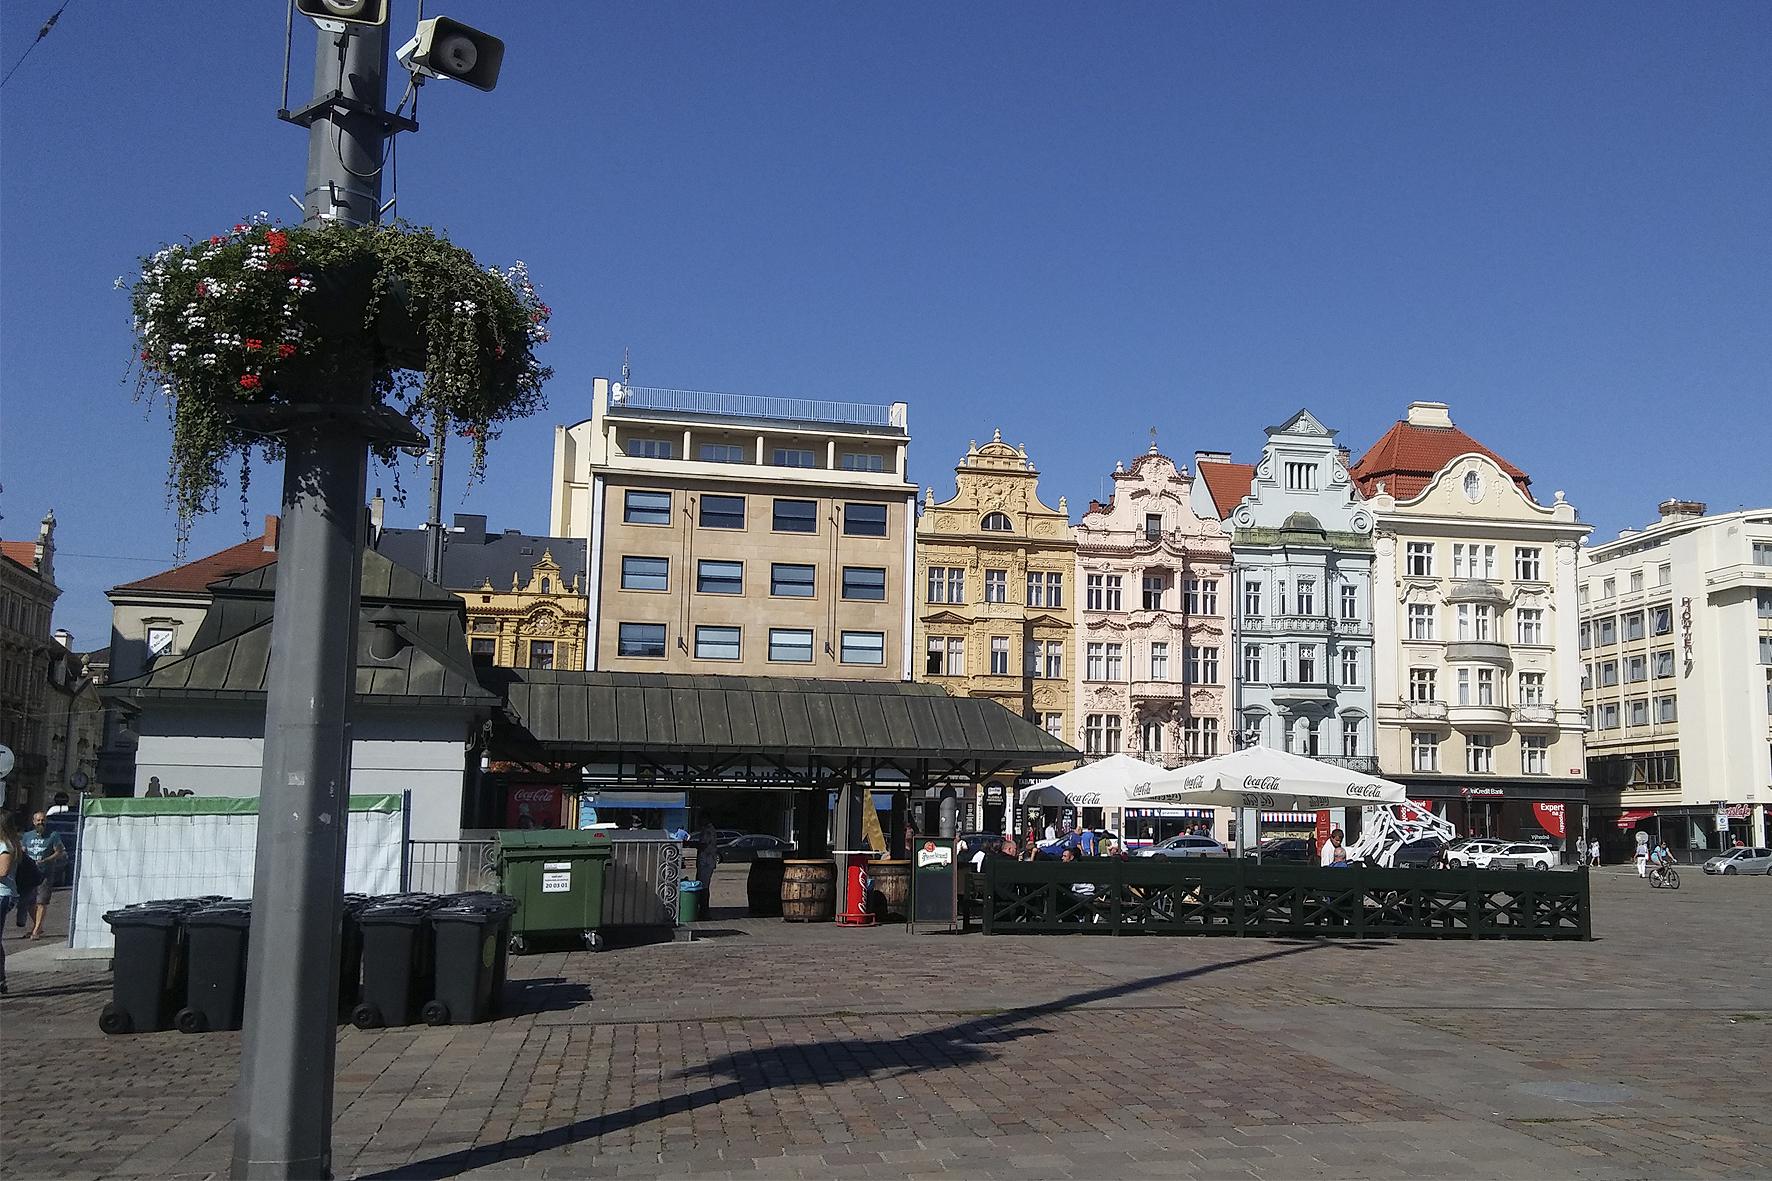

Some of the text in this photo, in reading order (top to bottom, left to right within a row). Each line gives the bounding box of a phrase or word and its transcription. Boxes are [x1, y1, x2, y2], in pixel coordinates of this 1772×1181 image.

[1243, 775, 1280, 790] Coca-Cola
[1346, 782, 1382, 798] Coca-Cola
[1065, 792, 1101, 804] Coca-Cola
[1540, 803, 1564, 812] Expert
